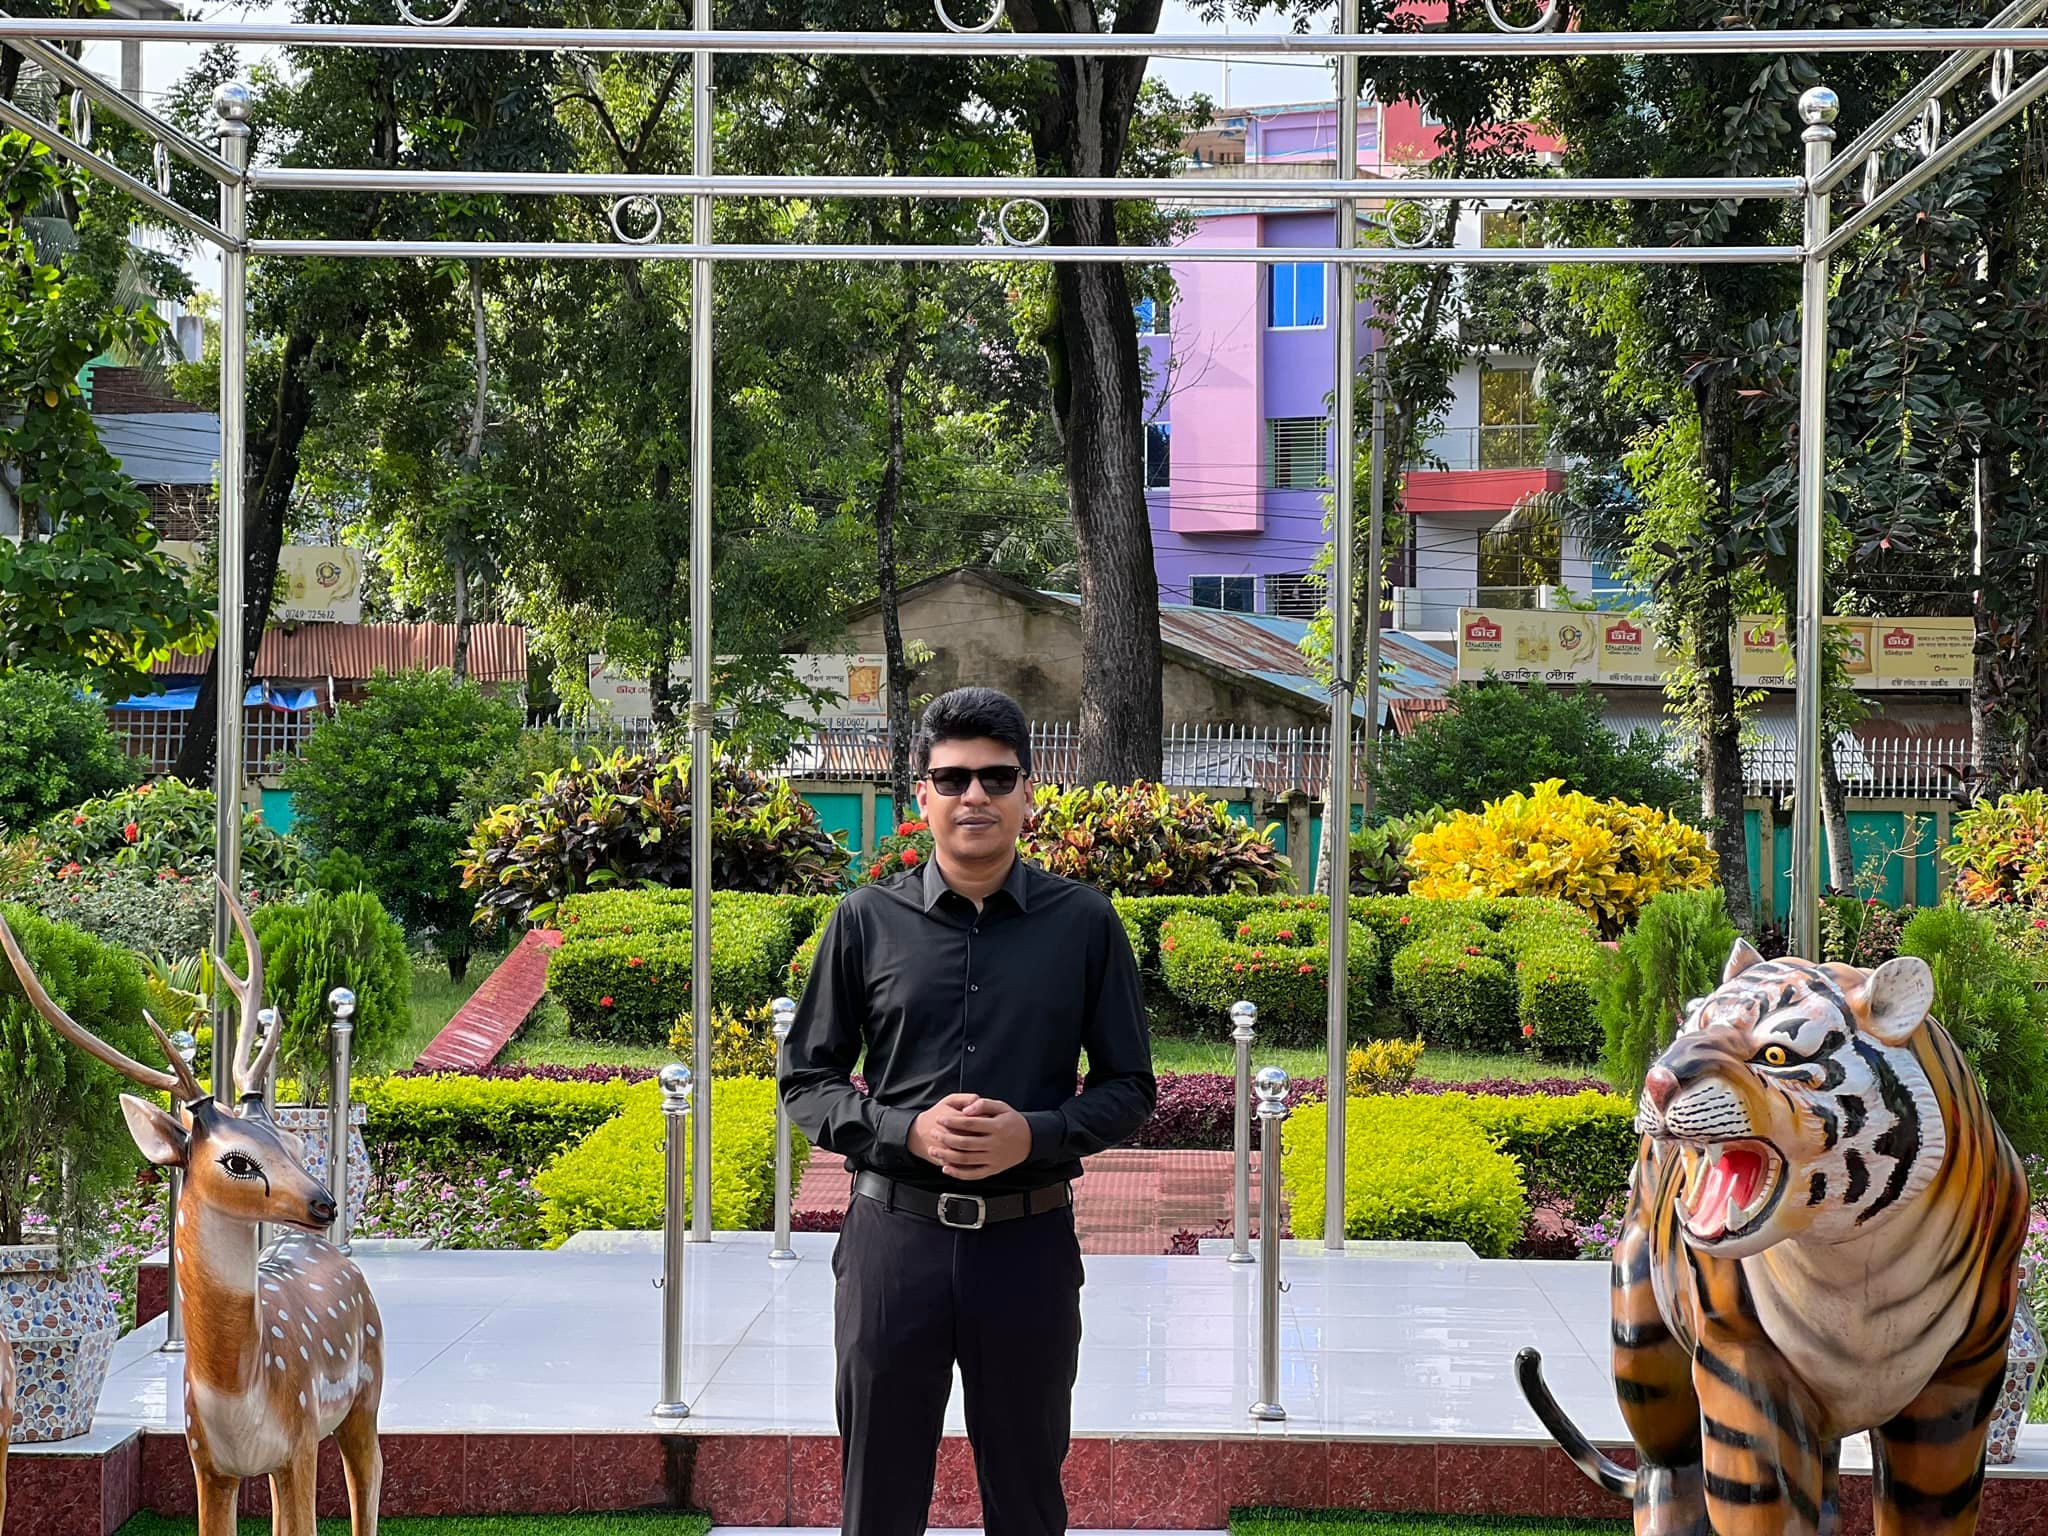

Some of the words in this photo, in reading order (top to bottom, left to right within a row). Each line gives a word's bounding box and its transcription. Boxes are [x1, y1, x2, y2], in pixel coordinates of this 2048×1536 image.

[1471, 627, 1497, 639] তীর
[1611, 630, 1637, 642] তীর
[1888, 637, 1910, 646] তীর
[1545, 669, 1577, 681] স্টোর
